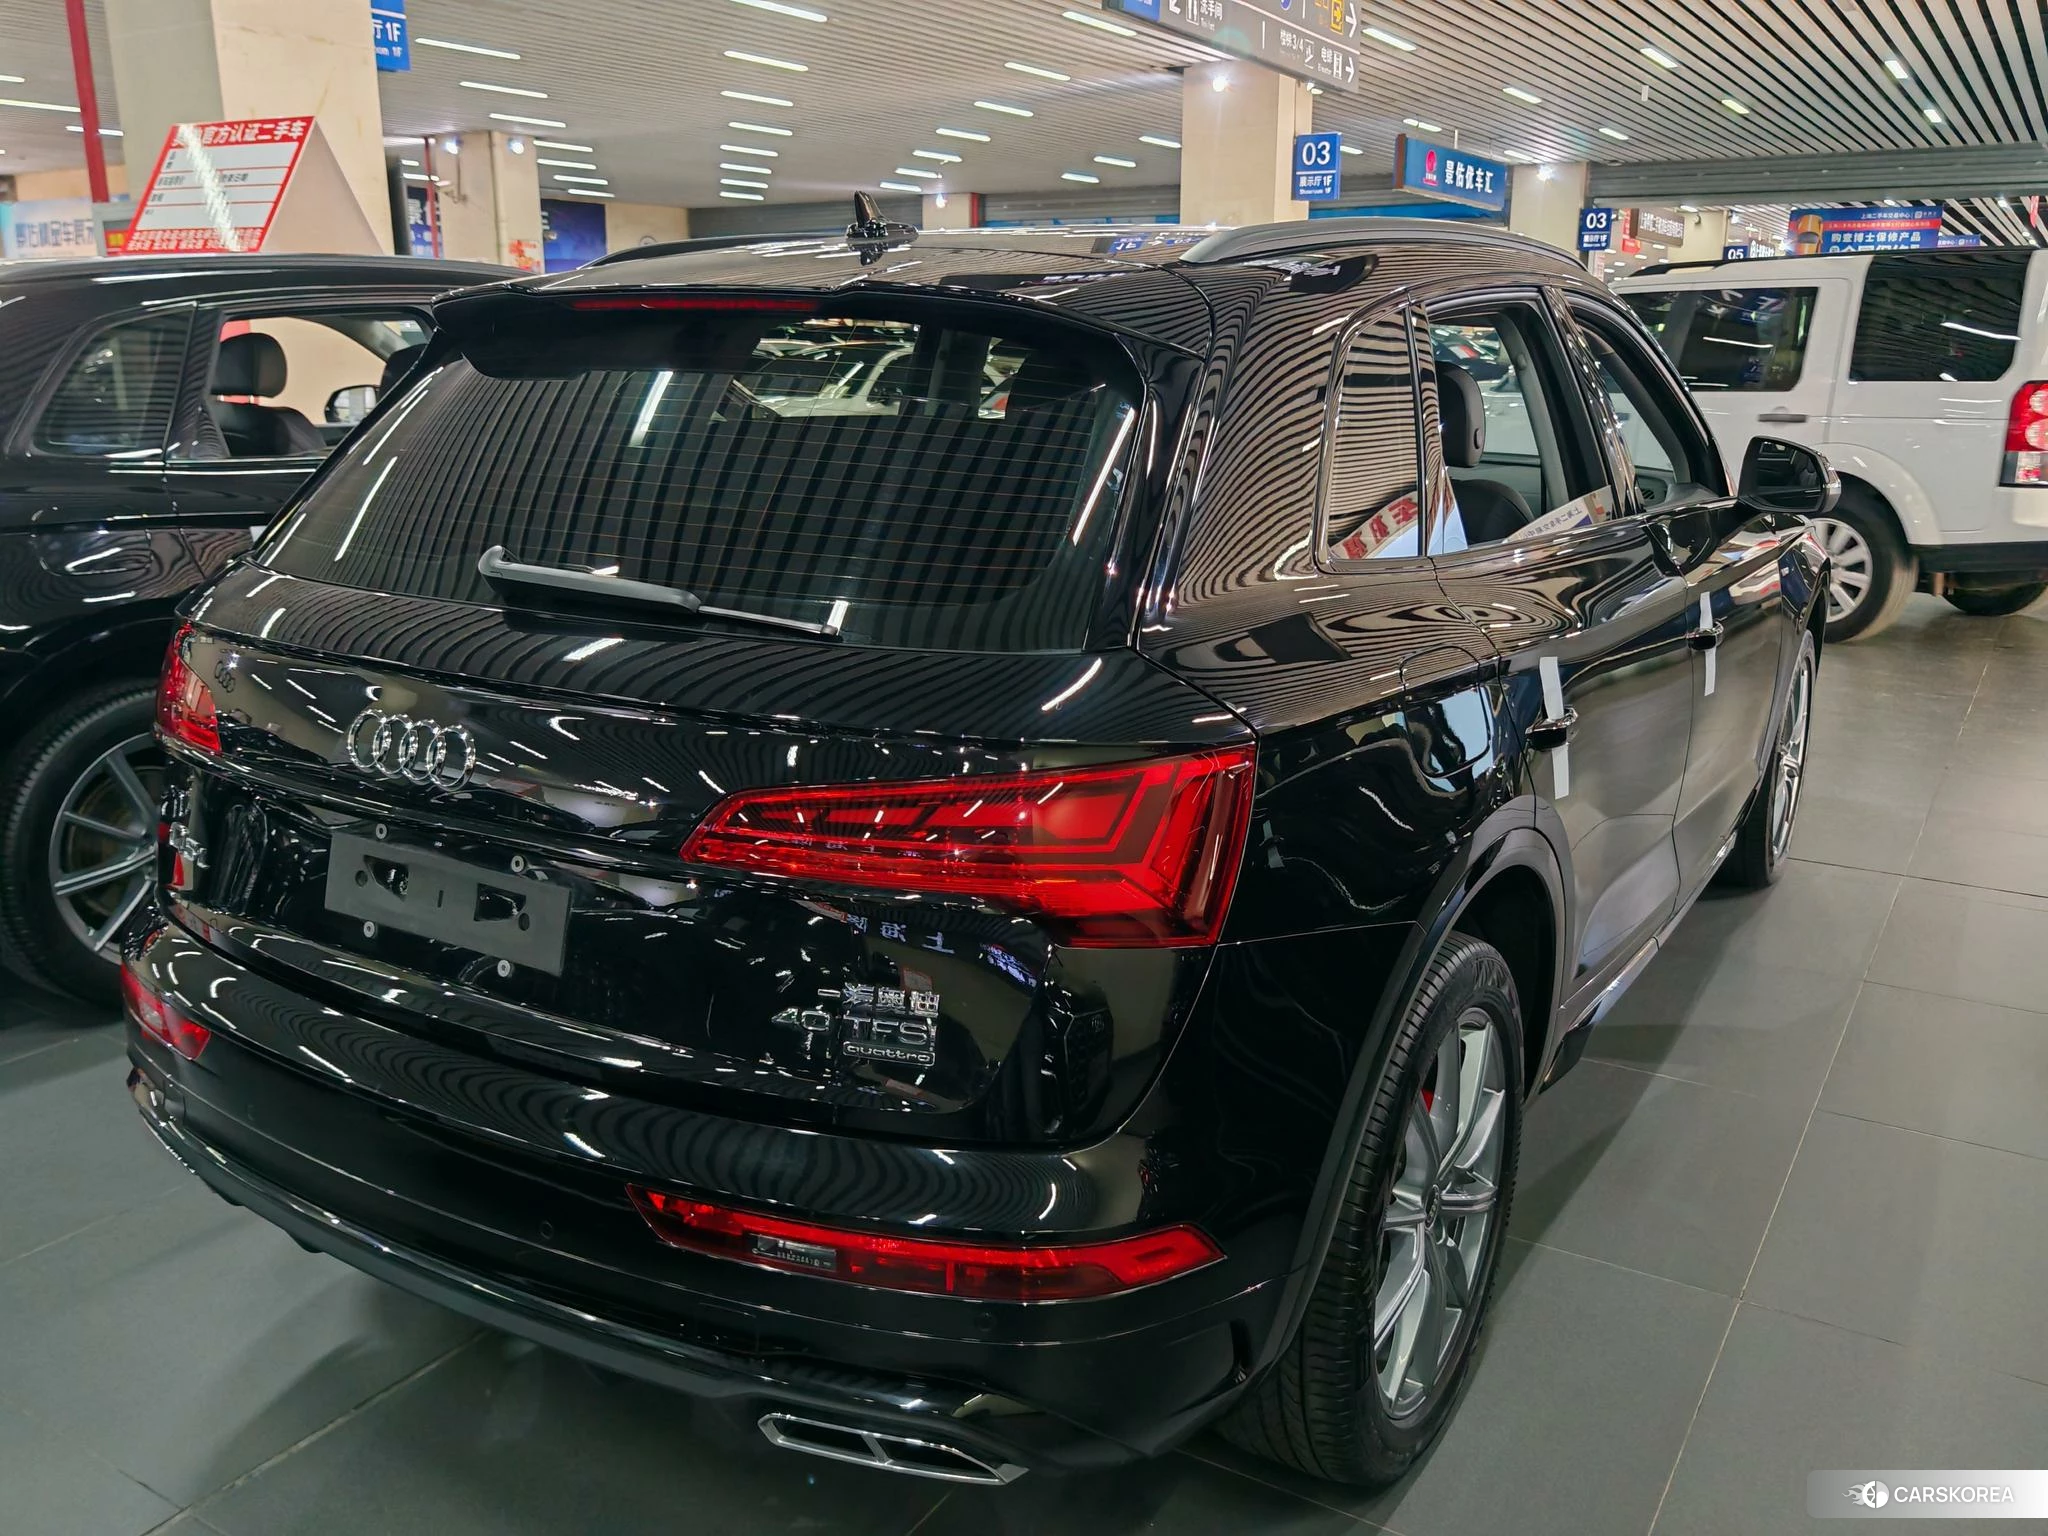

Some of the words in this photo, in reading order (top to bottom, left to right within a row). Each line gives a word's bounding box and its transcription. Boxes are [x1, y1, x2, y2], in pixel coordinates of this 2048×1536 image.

[385, 21, 401, 42] 1F
[172, 120, 307, 147] 官方认证二手车
[1302, 141, 1331, 166] 03
[1299, 175, 1322, 187] 展示厅
[1323, 175, 1332, 187] 1F
[1445, 159, 1494, 194] 景佑优车汇
[1586, 212, 1607, 229] 03
[1728, 249, 1744, 259] 05
[771, 1008, 830, 1031] 40
[843, 1013, 938, 1051] TFSI
[846, 1045, 931, 1063] quattro
